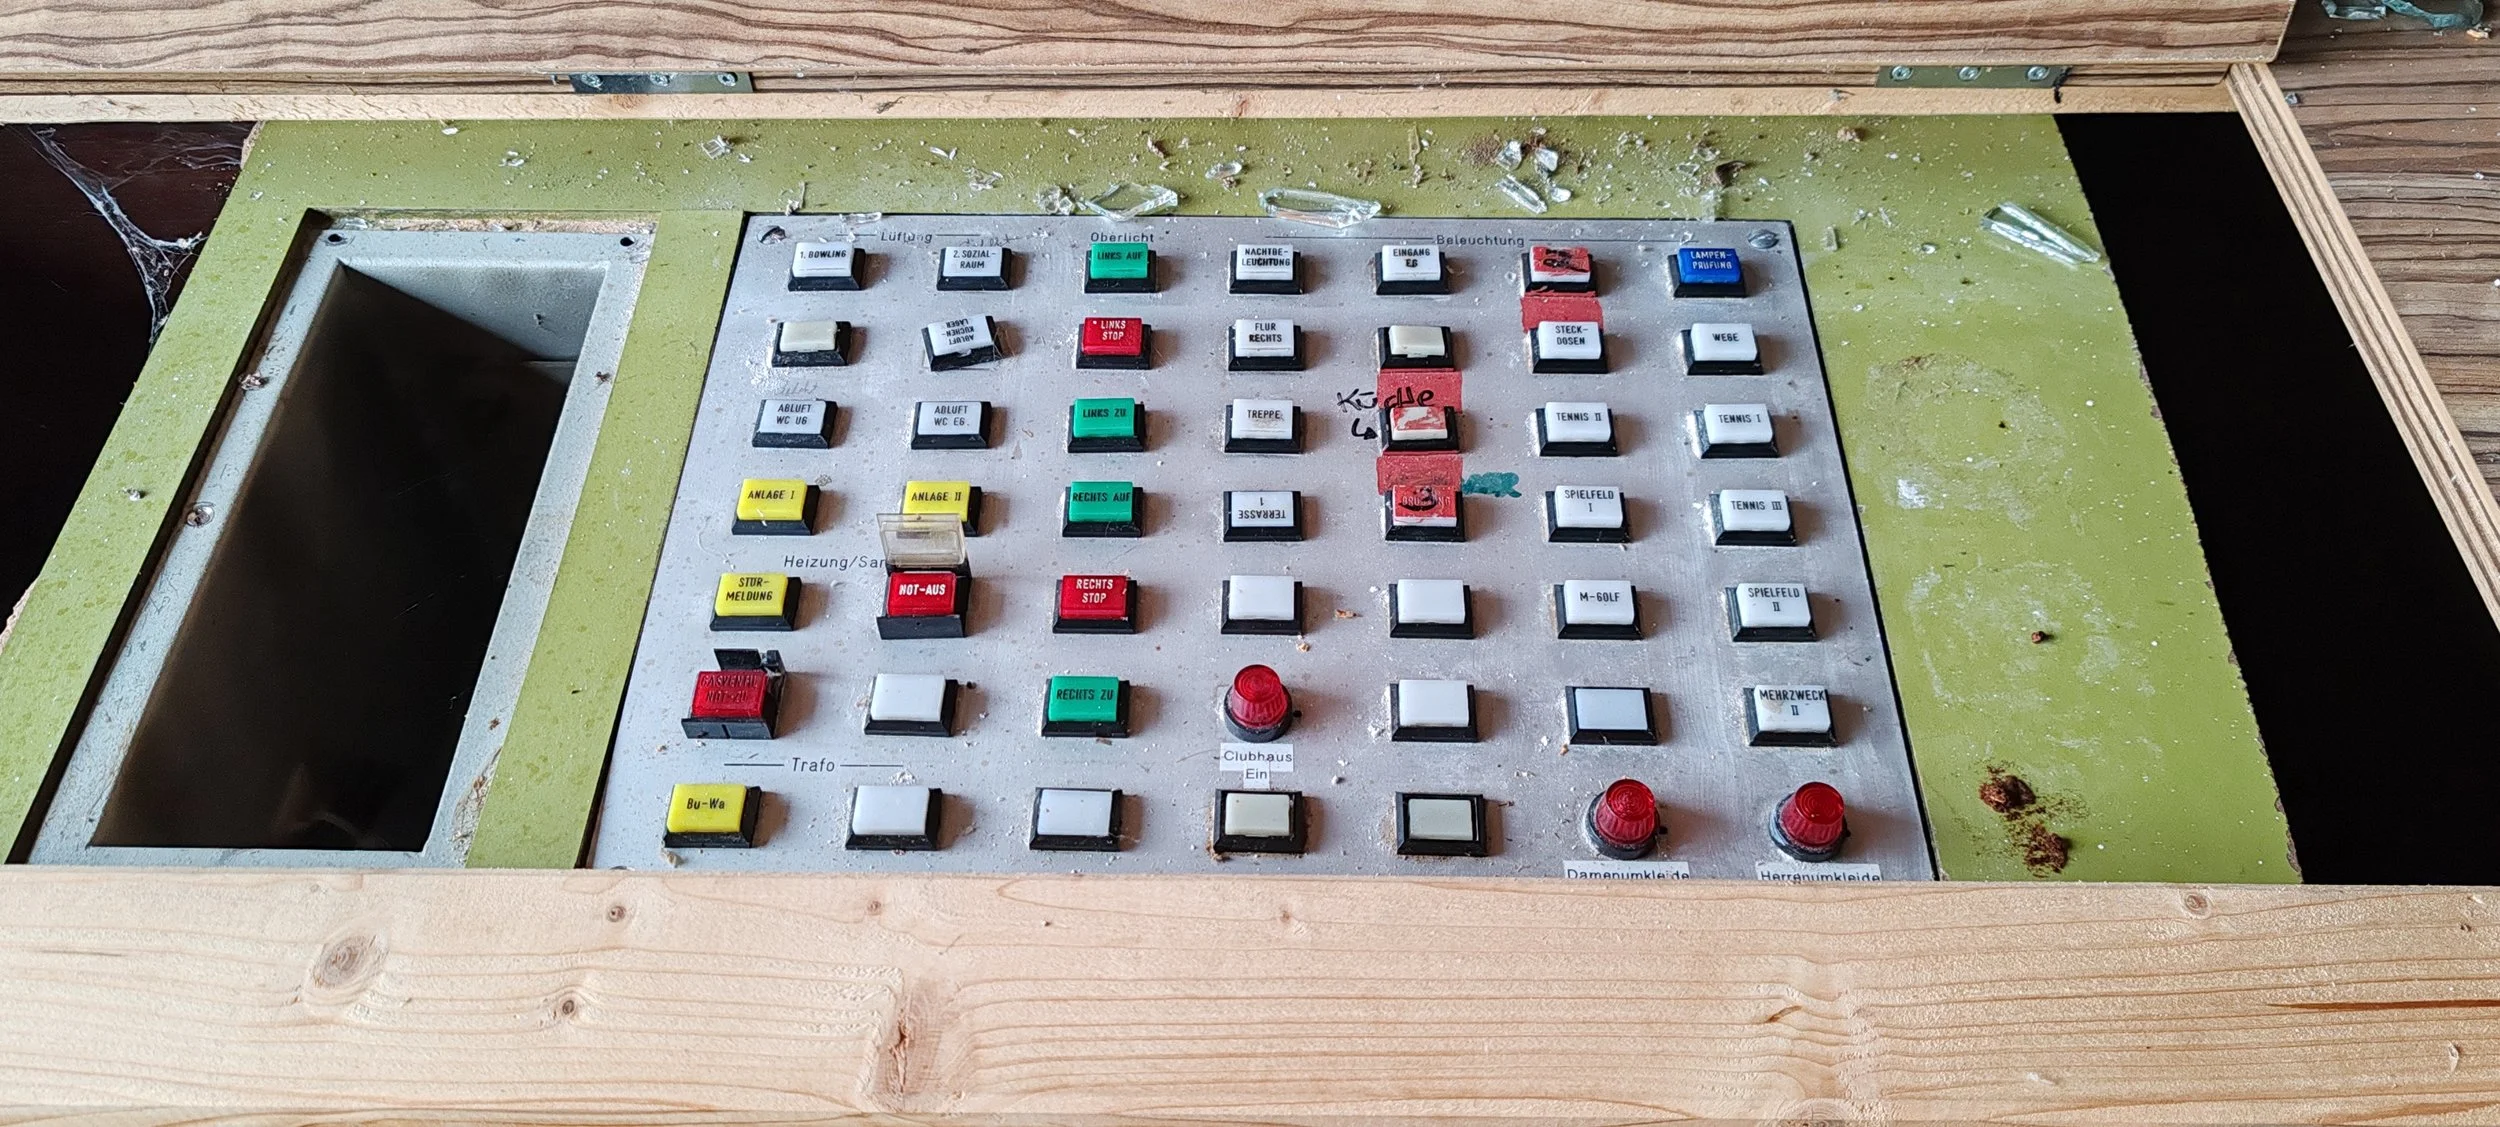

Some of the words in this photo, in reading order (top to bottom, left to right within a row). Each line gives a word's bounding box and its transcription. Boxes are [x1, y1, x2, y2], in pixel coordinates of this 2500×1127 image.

[880, 231, 933, 244] Lüftung
[1090, 232, 1154, 243] Oberlicht
[1436, 235, 1525, 247] Beleuchtung
[808, 250, 847, 259] BOWLING
[953, 250, 960, 258] 2.
[961, 250, 997, 258] SOZIAL-
[1098, 251, 1122, 260] LINKS
[1126, 251, 1143, 260] AUF
[1244, 247, 1289, 256] NACHTBE-
[1393, 248, 1431, 257] EINGANG
[1690, 251, 1732, 260] LAMPEN-
[959, 260, 985, 269] RAUM
[1241, 257, 1291, 267] LEUCHTUNG
[1405, 258, 1418, 268] EG
[1100, 320, 1127, 330] LINKS
[1254, 322, 1276, 332] FLUR
[1555, 325, 1588, 334] STECK-
[1102, 331, 1125, 341] STOP
[1248, 333, 1282, 343] RECHTS
[1556, 336, 1586, 346] DOSEN
[1712, 333, 1740, 342] WEGE
[777, 403, 812, 413] ABLUFT
[934, 405, 968, 415] ABLUFT
[1082, 408, 1110, 418] LINKS
[1114, 408, 1127, 418] ZU
[1247, 409, 1281, 420] TREPPE
[1556, 412, 1589, 422] TENNIS
[1718, 414, 1752, 424] TENNIS
[776, 415, 790, 425] WC
[795, 415, 808, 425] UG
[934, 416, 948, 426] WC
[747, 490, 786, 500] ANLAGE
[911, 491, 949, 501] ANLAGE
[1072, 492, 1108, 503] RECHTS
[1112, 492, 1132, 503] AUF
[1564, 490, 1615, 500] SPIELFELD
[1588, 502, 1593, 512] I
[1731, 500, 1766, 511] TENNIS
[1237, 509, 1287, 520] TERRASSE
[1076, 578, 1113, 590] RECHTS
[898, 584, 946, 596] NOT-AUS
[1748, 587, 1800, 598] SPIELFELD
[725, 590, 774, 601] MELDUNG
[1081, 592, 1107, 604] STOP
[1579, 591, 1620, 602] M-GOLF
[1056, 688, 1095, 701] RECHTS
[1100, 689, 1114, 701] ZU
[1759, 690, 1825, 701] MEHRZWECK
[1223, 750, 1293, 762] Clubhaus
[792, 757, 835, 772] Trafo
[1245, 768, 1268, 780] Ein
[686, 797, 725, 810] Bu-Wa
